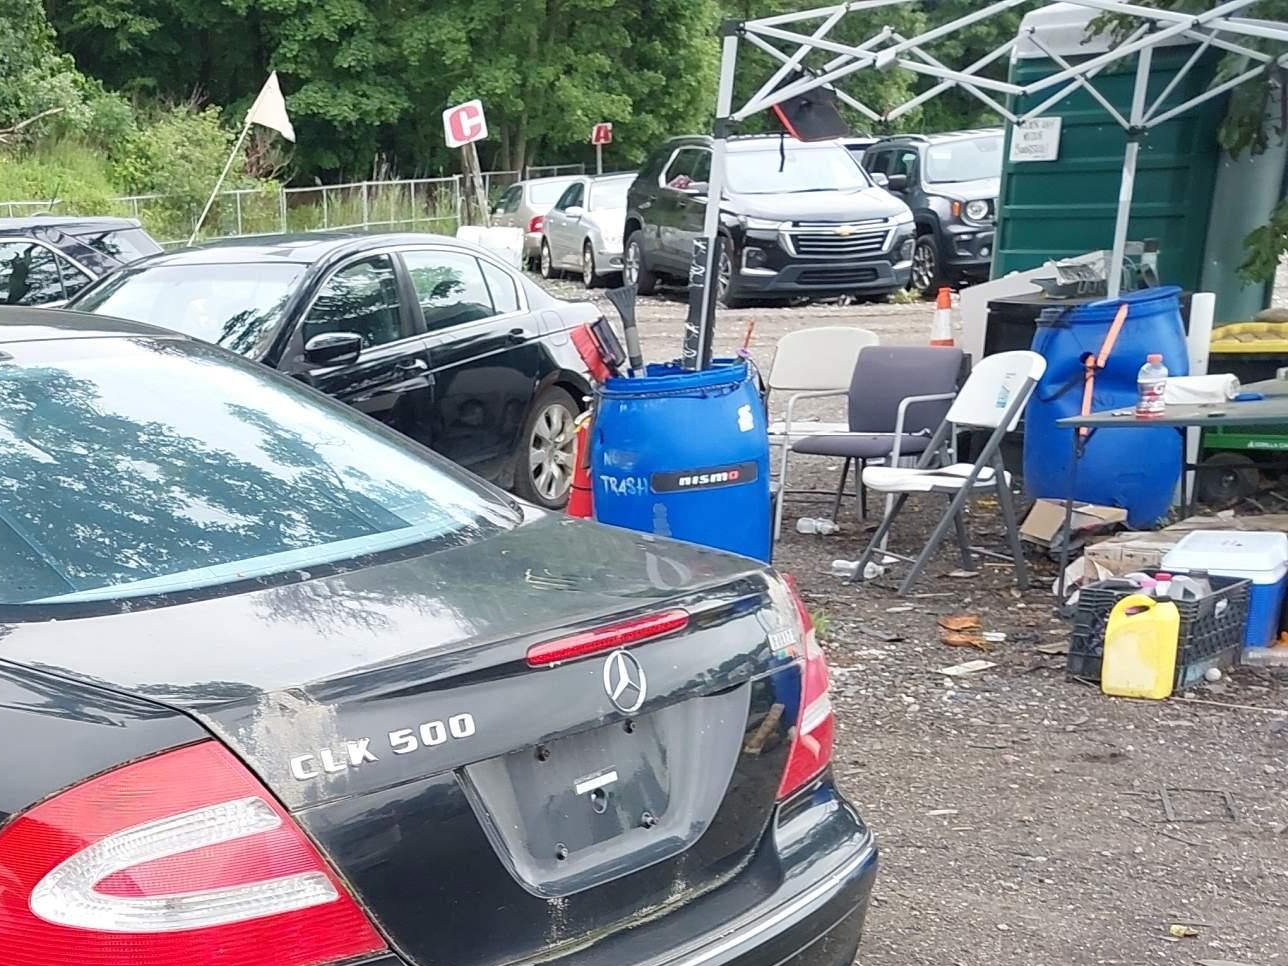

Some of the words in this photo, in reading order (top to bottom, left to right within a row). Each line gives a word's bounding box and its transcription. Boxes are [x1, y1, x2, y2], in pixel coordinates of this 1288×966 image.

[449, 105, 482, 142] C
[600, 475, 649, 497] TRASH
[290, 737, 379, 781] CLK
[388, 713, 476, 755] 500
